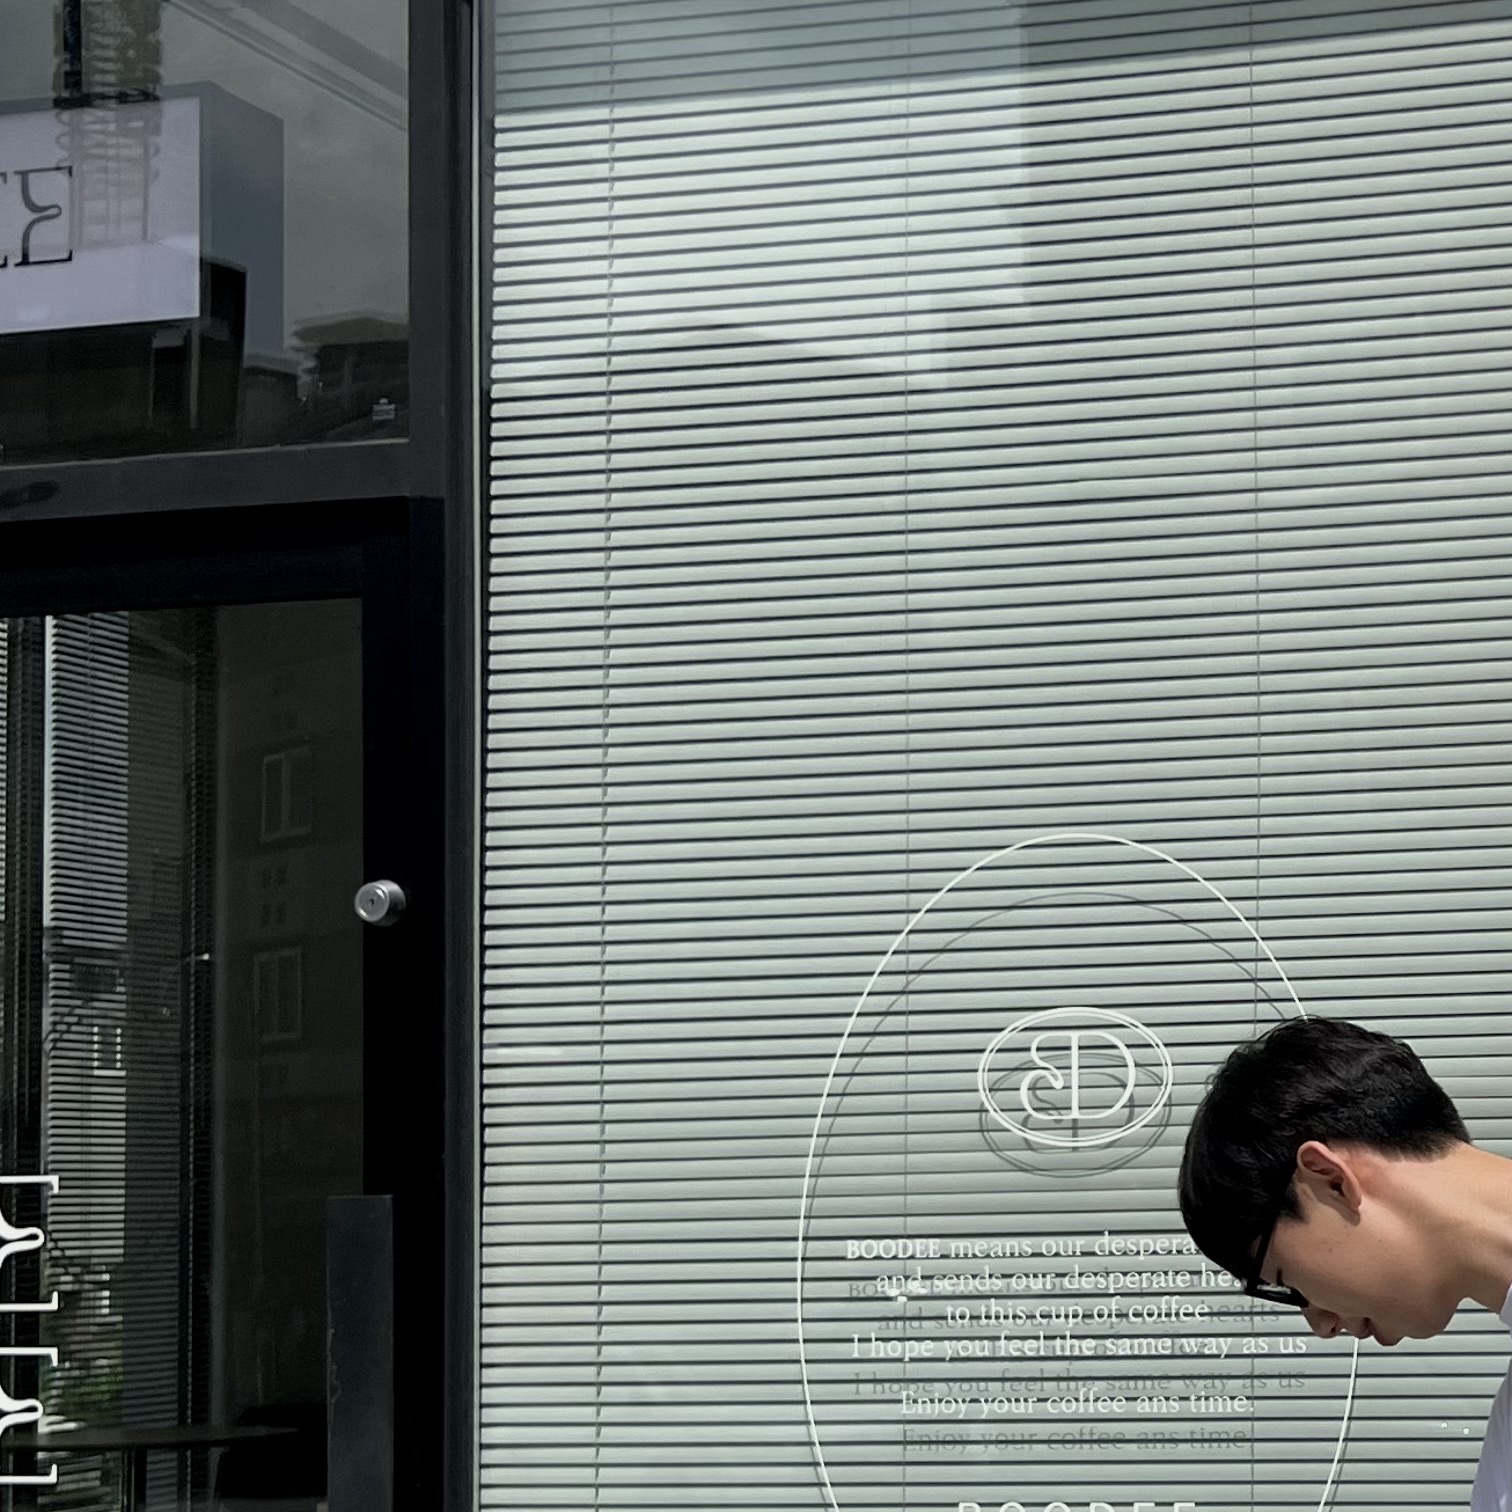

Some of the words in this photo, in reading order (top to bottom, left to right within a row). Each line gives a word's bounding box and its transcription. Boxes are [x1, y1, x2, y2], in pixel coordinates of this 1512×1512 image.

[846, 1238, 941, 1259] BOODEE
[950, 1238, 1033, 1258] means
[1042, 1238, 1086, 1257] our
[1095, 1230, 1198, 1261] despera
[876, 1266, 924, 1292] and
[933, 1265, 1002, 1291] sends
[1012, 1272, 1056, 1290] our
[1064, 1264, 1191, 1294] desperate
[946, 1304, 970, 1323] to
[981, 1298, 1027, 1324] this
[1036, 1304, 1083, 1327] cup
[1093, 1295, 1121, 1323] of
[1128, 1295, 1211, 1322] coffee
[852, 1333, 860, 1358] I
[870, 1332, 935, 1362] hope
[944, 1339, 990, 1361] you
[1000, 1330, 1045, 1357] feel
[1054, 1331, 1097, 1355] the
[1105, 1337, 1173, 1355] same
[1182, 1336, 1233, 1359] way
[1242, 1336, 1269, 1354] as
[1279, 1336, 1307, 1354] us
[901, 1390, 972, 1419] Enjoy
[980, 1396, 1038, 1419] your
[1046, 1388, 1127, 1413] coffee
[1136, 1395, 1180, 1413] ans
